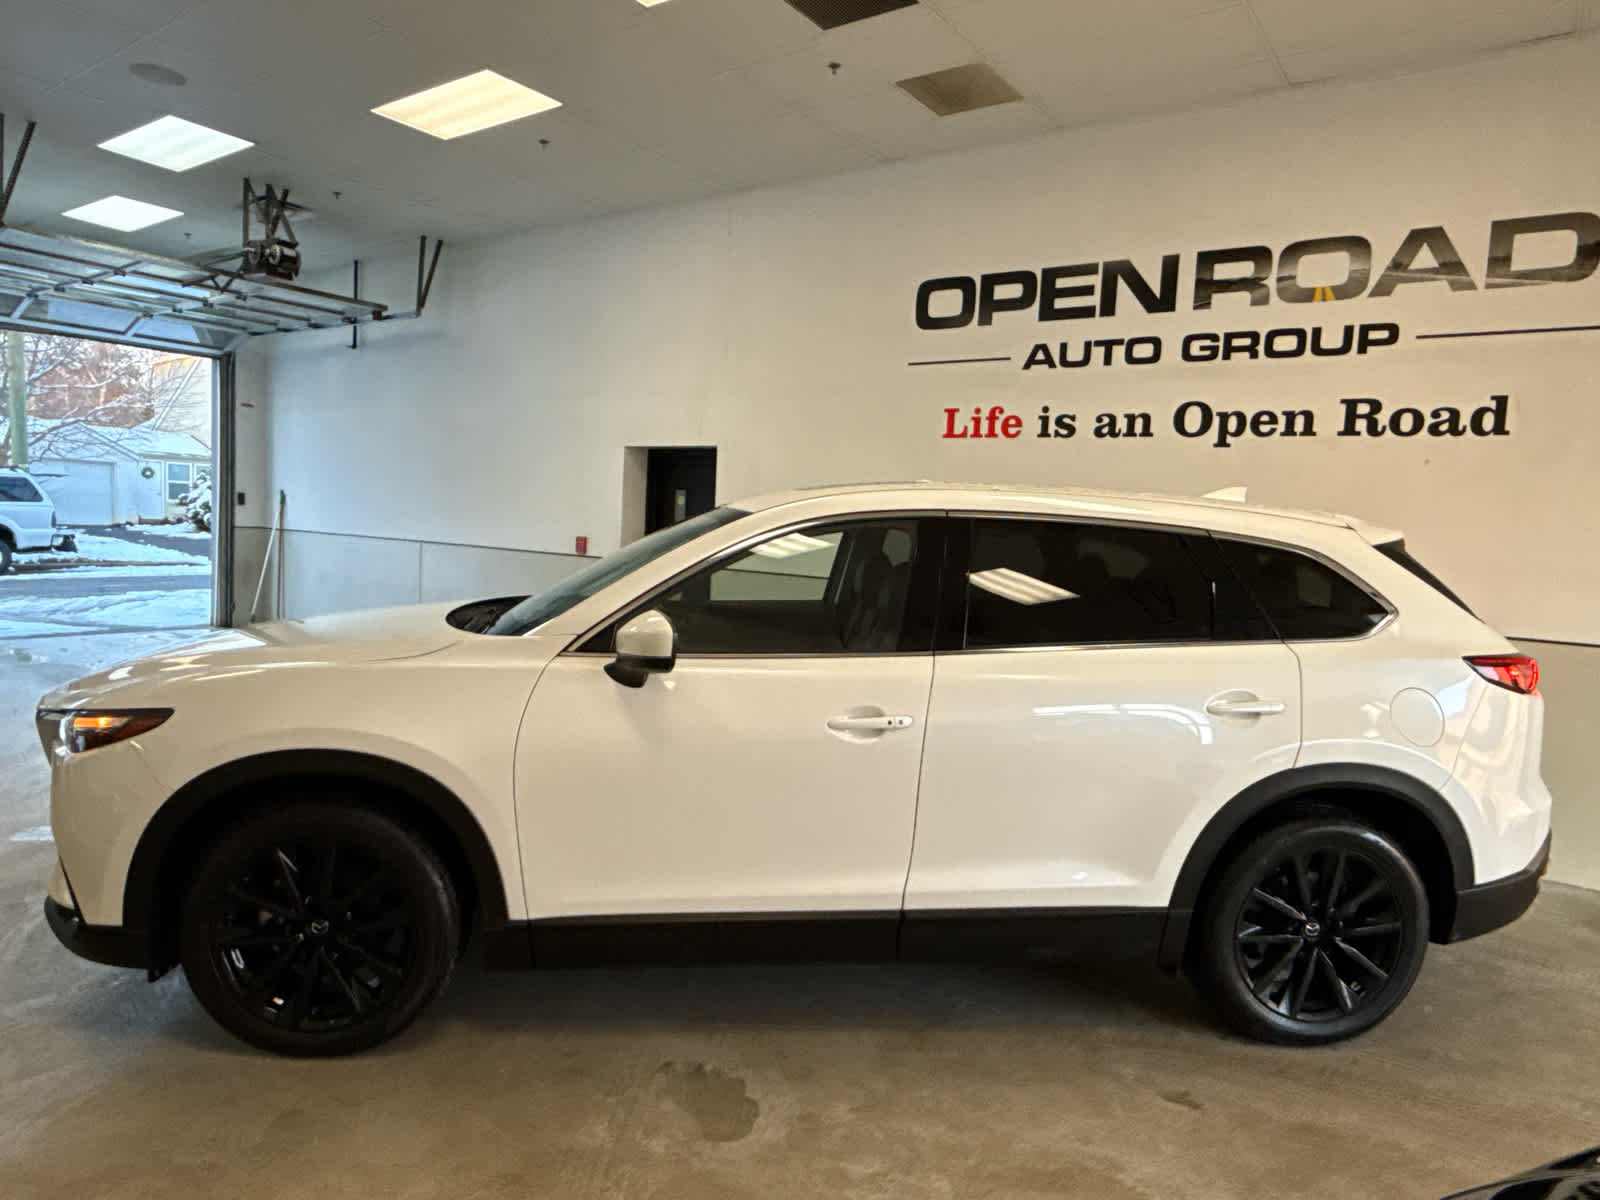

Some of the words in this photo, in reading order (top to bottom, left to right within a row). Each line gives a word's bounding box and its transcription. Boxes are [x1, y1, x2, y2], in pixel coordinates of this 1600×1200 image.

[915, 254, 1180, 330] OPEN
[1193, 211, 1600, 310] ROAD
[1022, 336, 1163, 370] AUTO
[1181, 323, 1401, 363] GROUP
[942, 406, 1023, 439] Life
[1037, 405, 1077, 439] is
[1093, 412, 1154, 439] an
[1173, 400, 1317, 448] Open
[1337, 394, 1511, 438] Road
